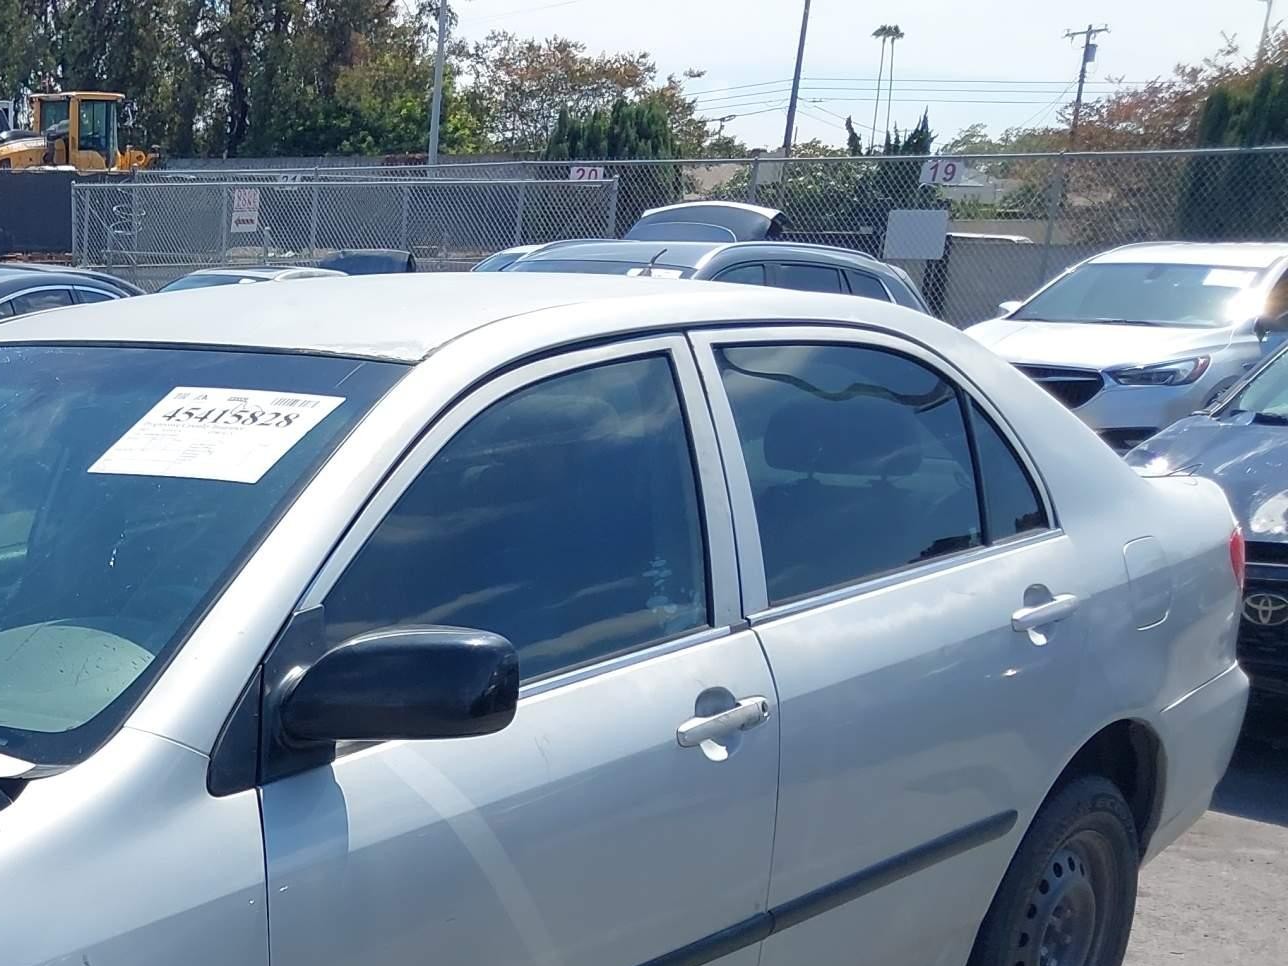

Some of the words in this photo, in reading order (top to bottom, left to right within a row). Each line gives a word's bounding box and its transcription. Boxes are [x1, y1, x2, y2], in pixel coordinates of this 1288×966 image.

[576, 167, 598, 181] 20
[929, 161, 957, 182] 19
[162, 406, 300, 428] 45415828
